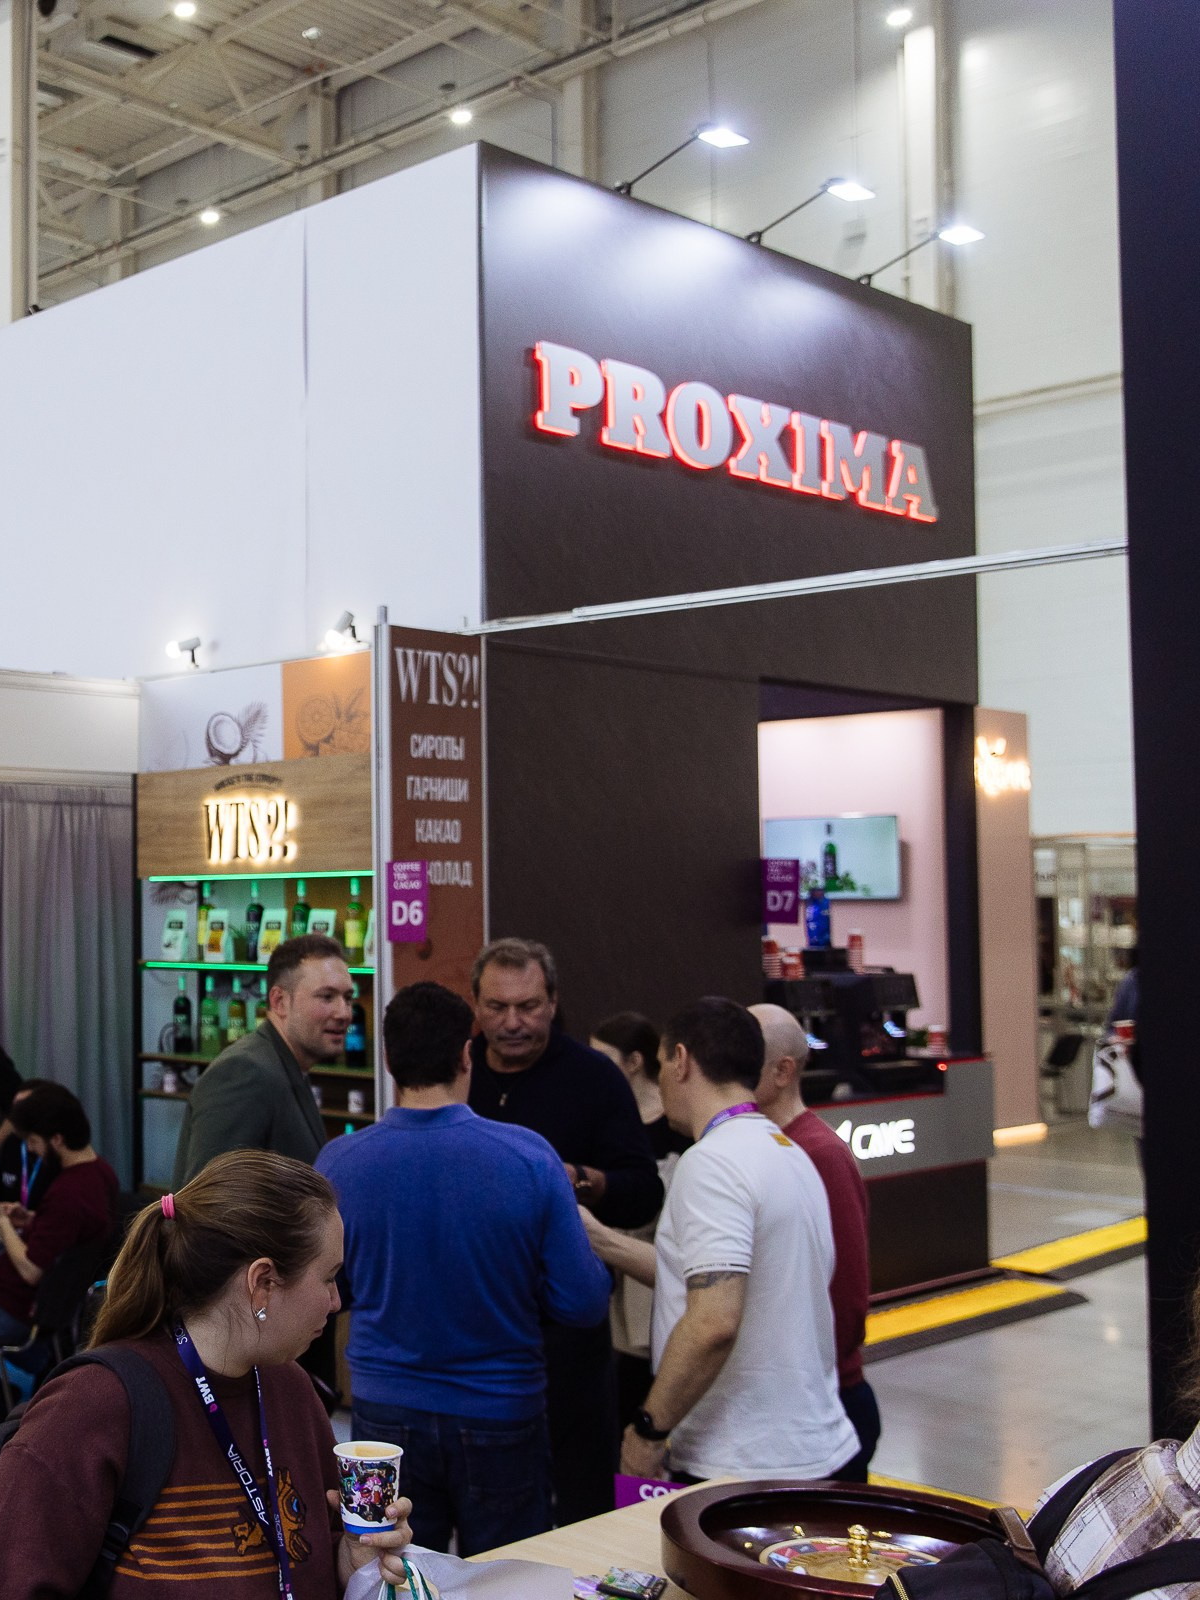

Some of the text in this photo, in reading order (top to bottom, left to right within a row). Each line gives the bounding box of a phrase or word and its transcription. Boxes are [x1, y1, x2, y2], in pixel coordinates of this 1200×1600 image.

[533, 341, 938, 523] PROXIMA
[394, 646, 480, 708] WTS?!
[410, 733, 465, 760] СИРОПЫ
[407, 775, 469, 802] ГАРНИШИ
[203, 798, 296, 863] WTS?!
[415, 818, 462, 844] КАКАО
[391, 900, 424, 926] D6
[766, 890, 795, 912] D7
[195, 1376, 215, 1405] BWT
[227, 1443, 270, 1526] ASTORIA
